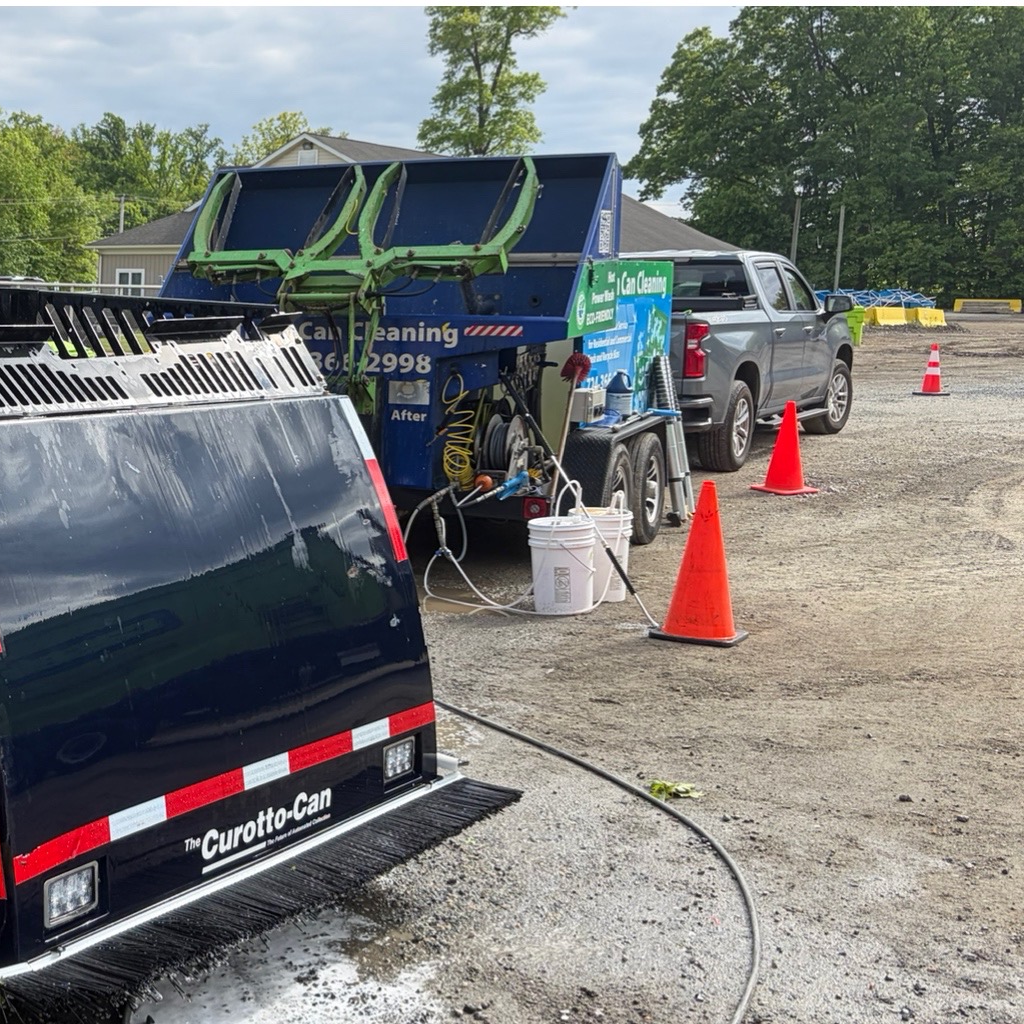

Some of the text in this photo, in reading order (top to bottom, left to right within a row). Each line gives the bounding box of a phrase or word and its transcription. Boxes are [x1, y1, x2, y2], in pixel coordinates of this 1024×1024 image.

[621, 271, 636, 295] Can
[637, 270, 667, 298] Cleaning
[390, 409, 427, 422] After
[184, 787, 332, 860] The Curotto-Can
